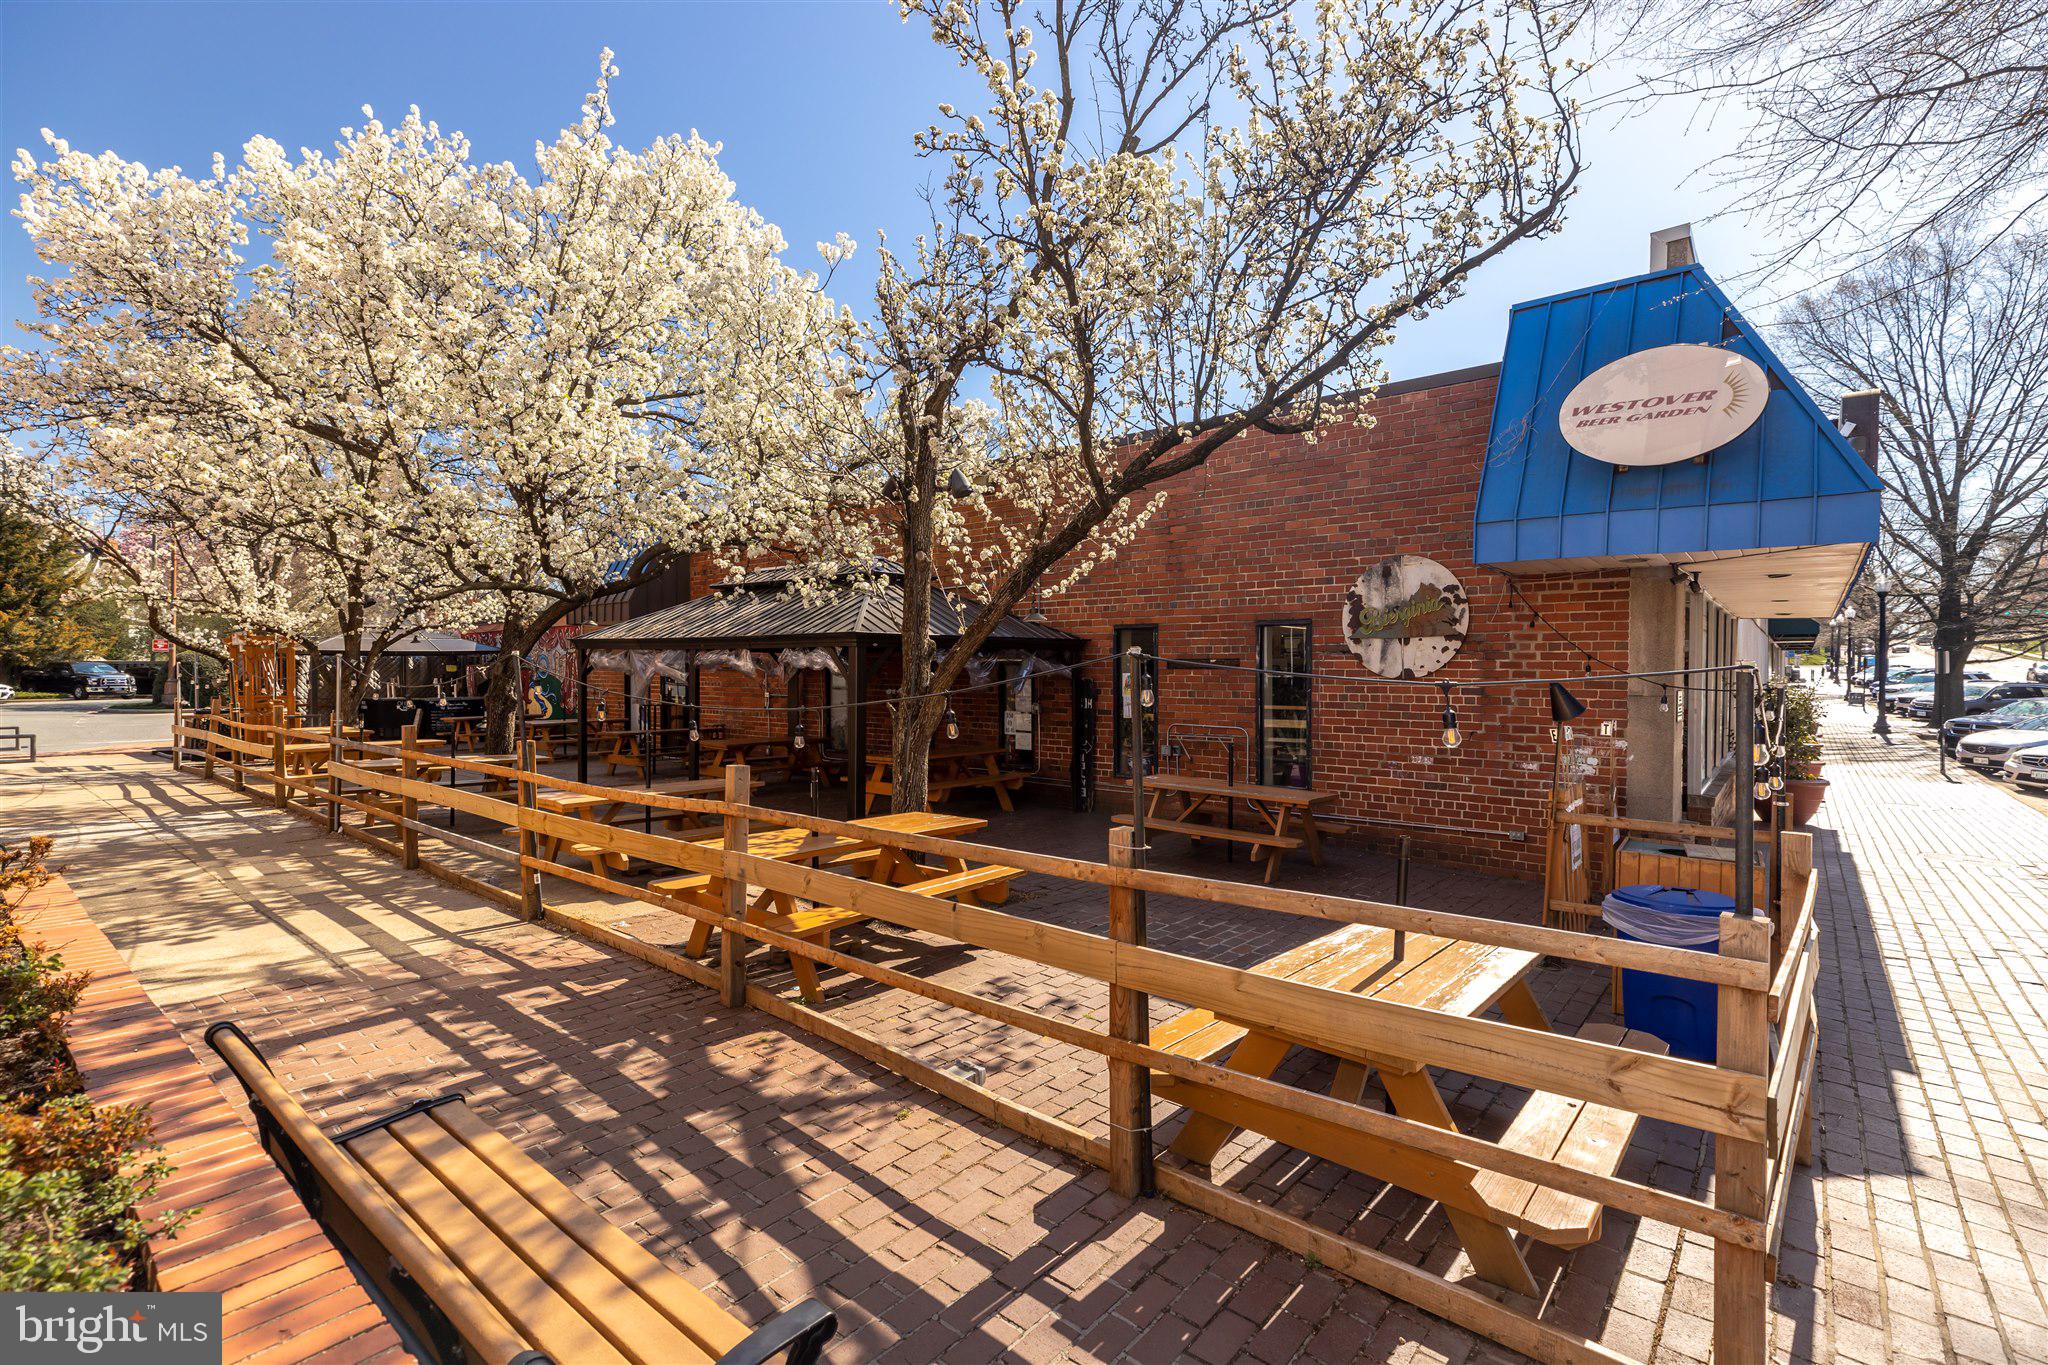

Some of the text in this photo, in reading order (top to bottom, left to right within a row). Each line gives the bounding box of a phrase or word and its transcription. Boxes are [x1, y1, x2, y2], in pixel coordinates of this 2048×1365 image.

[1572, 389, 1718, 417] WESTOVER
[1576, 404, 1712, 428] BEER GARDEN
